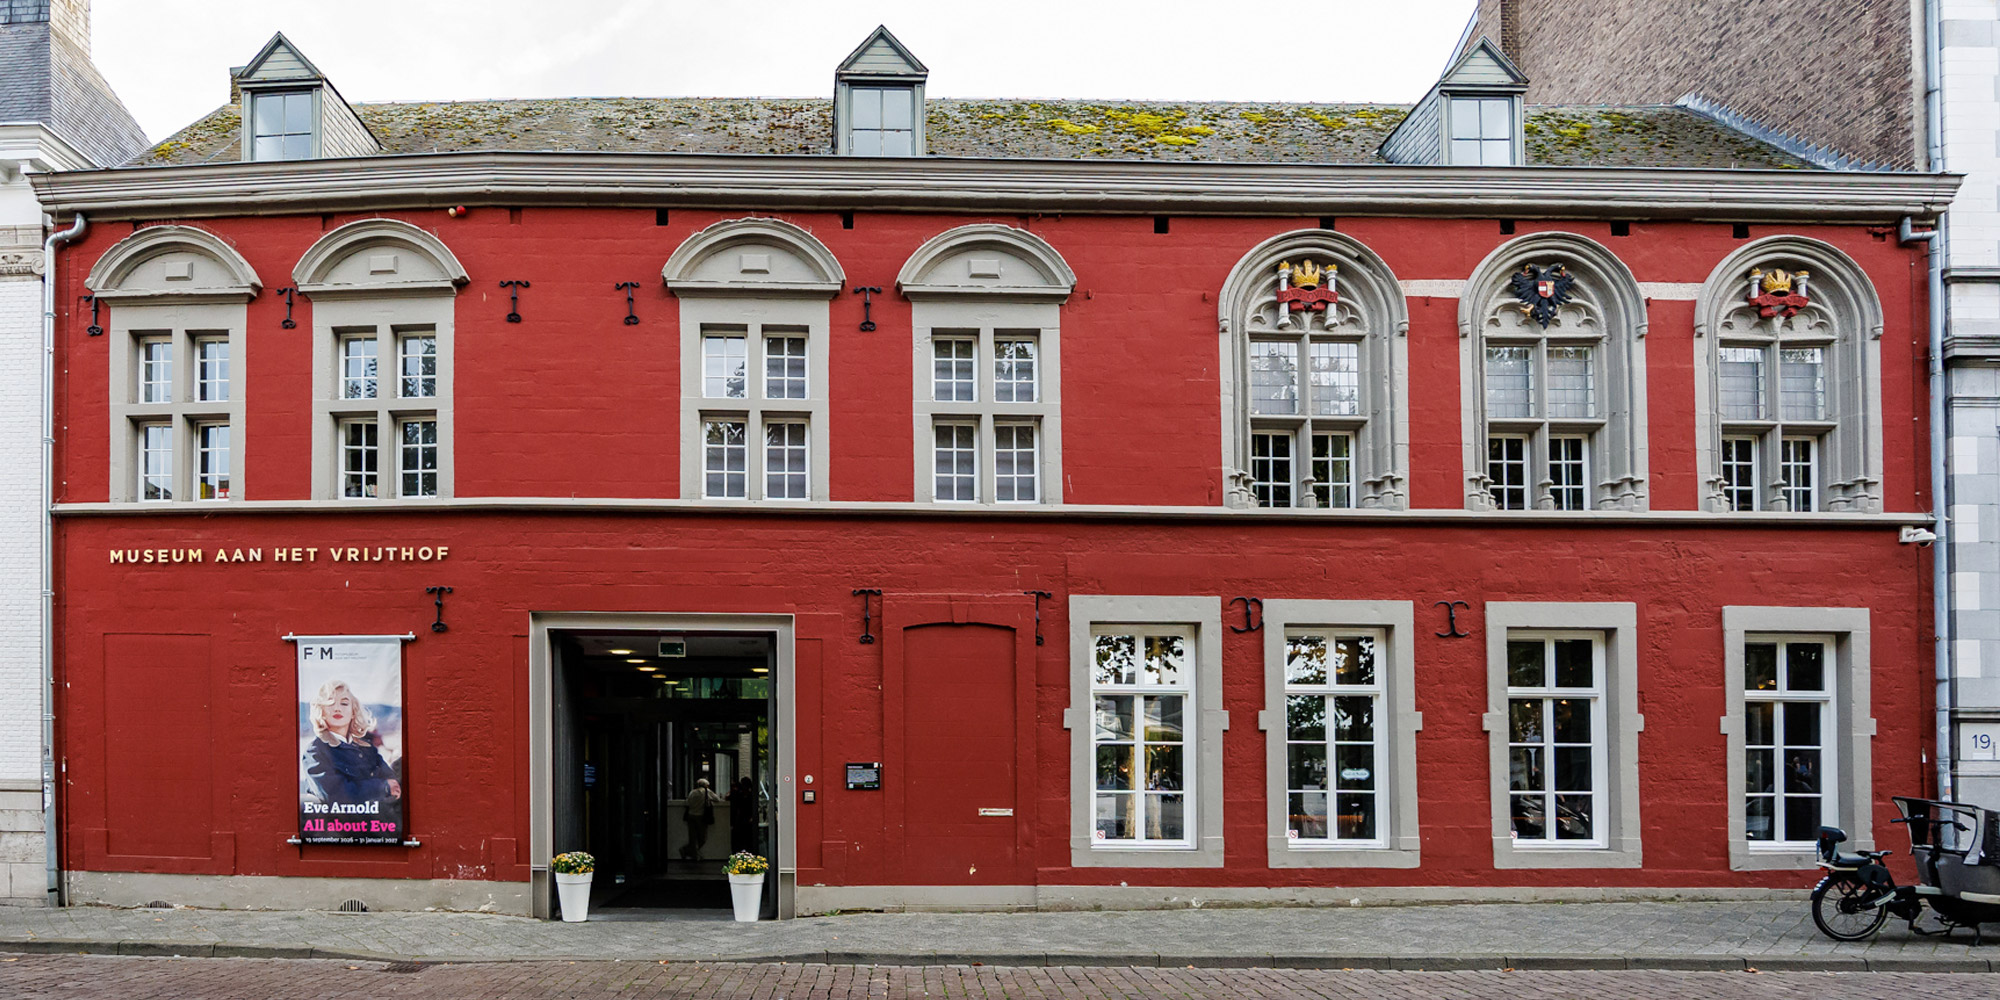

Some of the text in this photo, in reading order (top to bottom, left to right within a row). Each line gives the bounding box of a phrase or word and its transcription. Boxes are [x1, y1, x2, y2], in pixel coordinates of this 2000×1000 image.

[110, 546, 449, 563] MUSEUM AAN HET VRIJTHOF
[1972, 734, 1991, 750] 19
[304, 801, 379, 814] Eve Arnold
[303, 819, 396, 832] All about Eve
